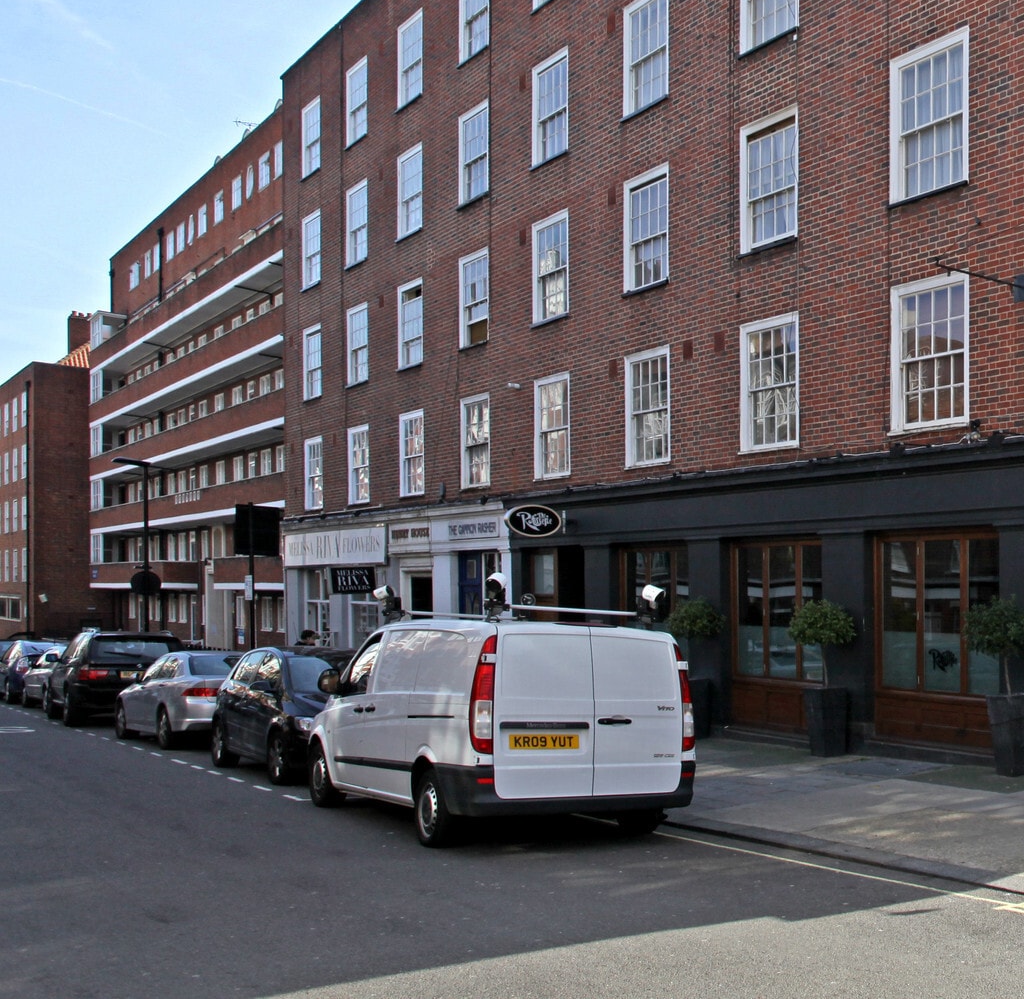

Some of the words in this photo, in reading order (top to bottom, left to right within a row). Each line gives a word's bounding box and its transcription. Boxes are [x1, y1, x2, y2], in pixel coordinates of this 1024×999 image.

[448, 525, 457, 535] THE
[478, 522, 496, 533] RASHER
[288, 542, 314, 557] MELISSA
[316, 535, 340, 559] RIVA
[342, 535, 380, 553] FLOWERS
[337, 576, 369, 586] RIVA
[514, 736, 547, 747] KR09
[551, 736, 573, 747] YUT
